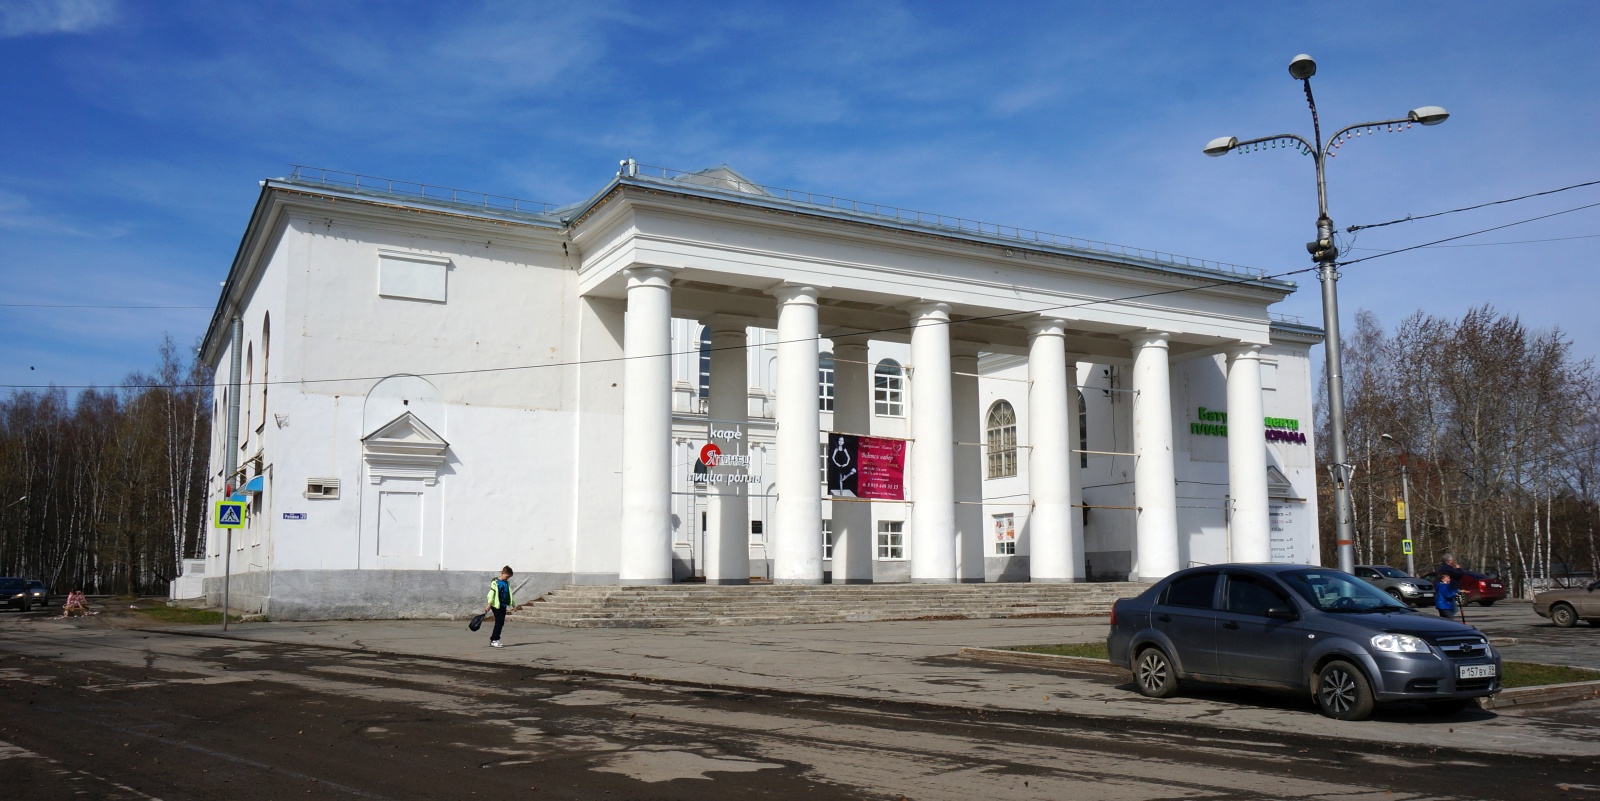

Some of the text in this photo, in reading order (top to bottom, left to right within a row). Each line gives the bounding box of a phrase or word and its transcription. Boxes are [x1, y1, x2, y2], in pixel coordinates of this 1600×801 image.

[1198, 406, 1299, 431] Бату центр
[710, 429, 742, 442] кафе
[1191, 423, 1307, 445] ПЛАН ОРАМА
[687, 472, 762, 486] пицца роллы
